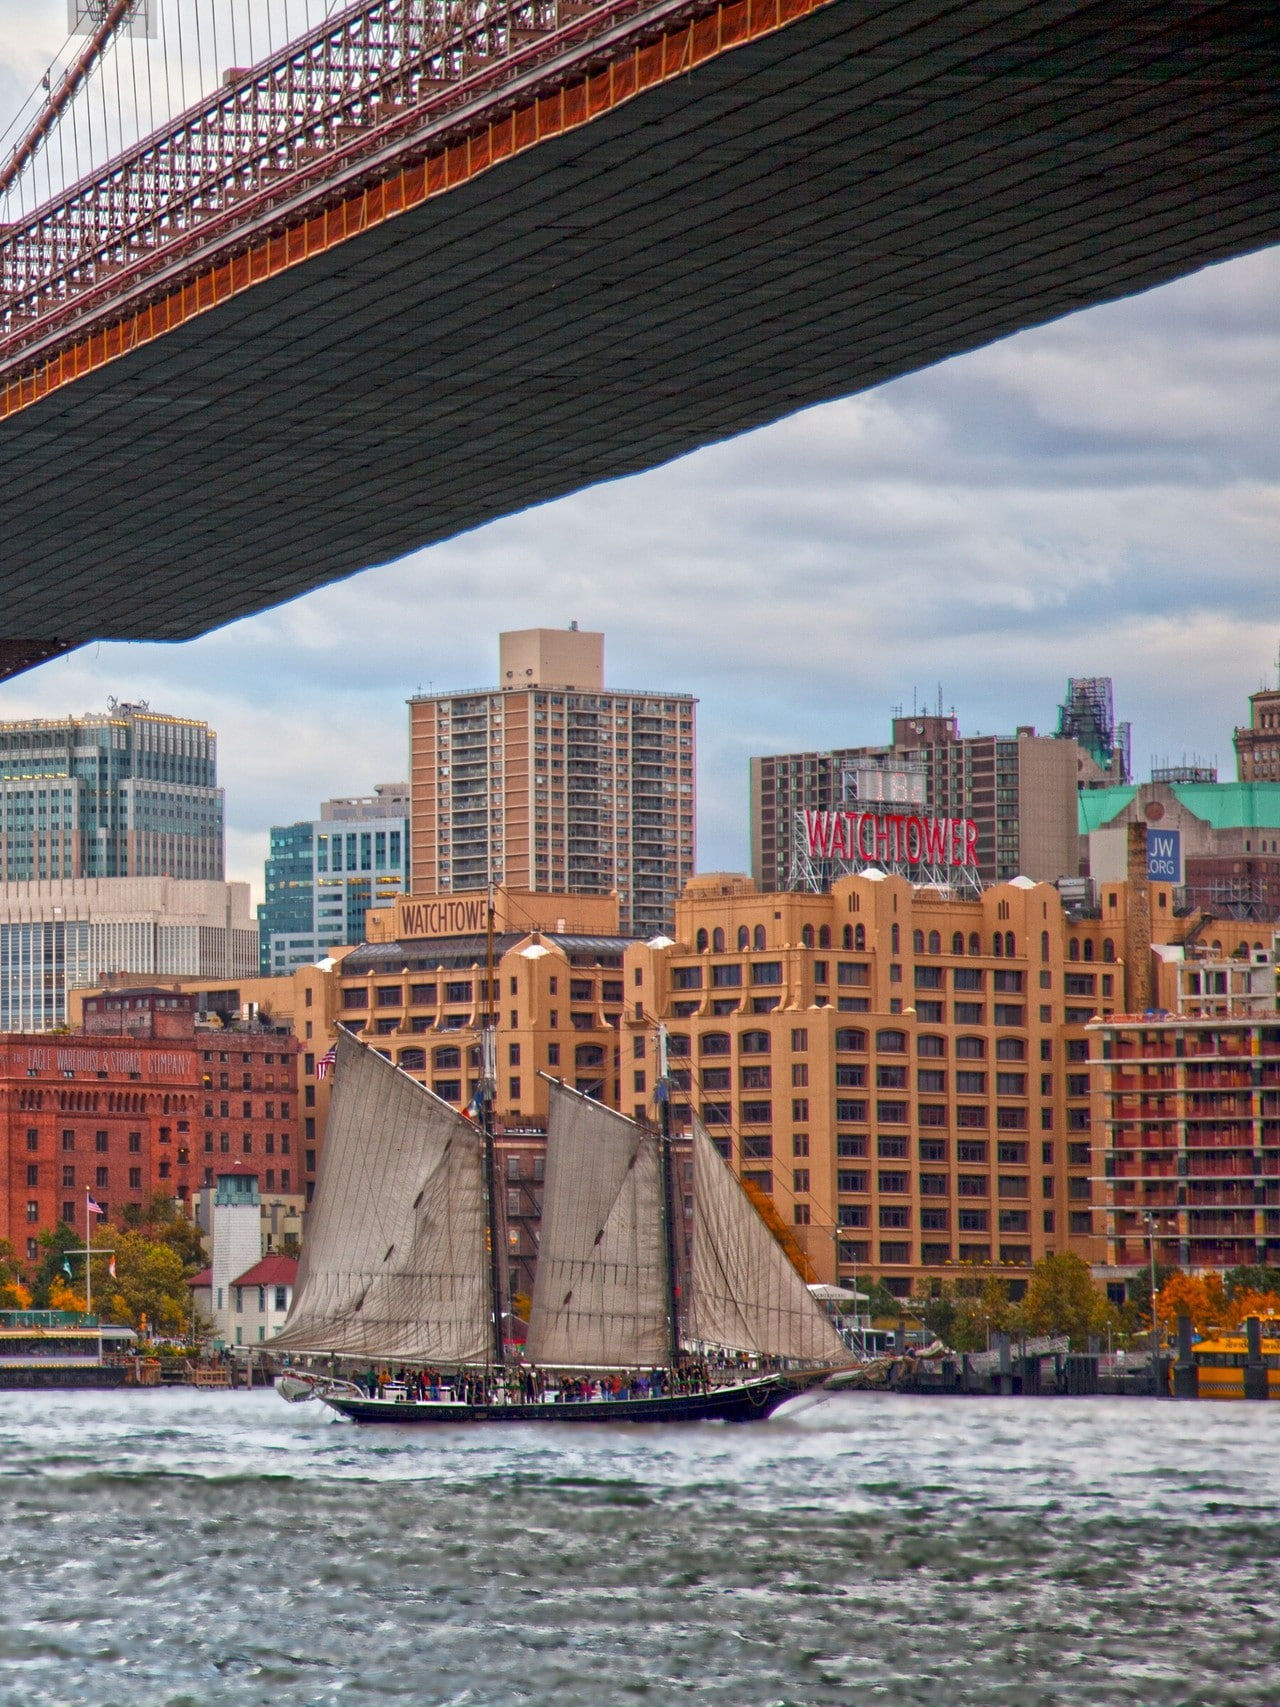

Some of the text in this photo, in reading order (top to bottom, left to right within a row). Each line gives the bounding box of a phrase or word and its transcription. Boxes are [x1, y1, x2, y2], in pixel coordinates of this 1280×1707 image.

[803, 809, 981, 867] WATCHTOWER
[1150, 837, 1174, 857] JW
[1147, 859, 1175, 875] .ORG
[27, 1048, 51, 1071] EAGLE
[56, 1049, 99, 1073] WAREHOUSE
[102, 1051, 109, 1072] &
[110, 1050, 142, 1074] STORAGE
[147, 1053, 192, 1075] COMPANY
